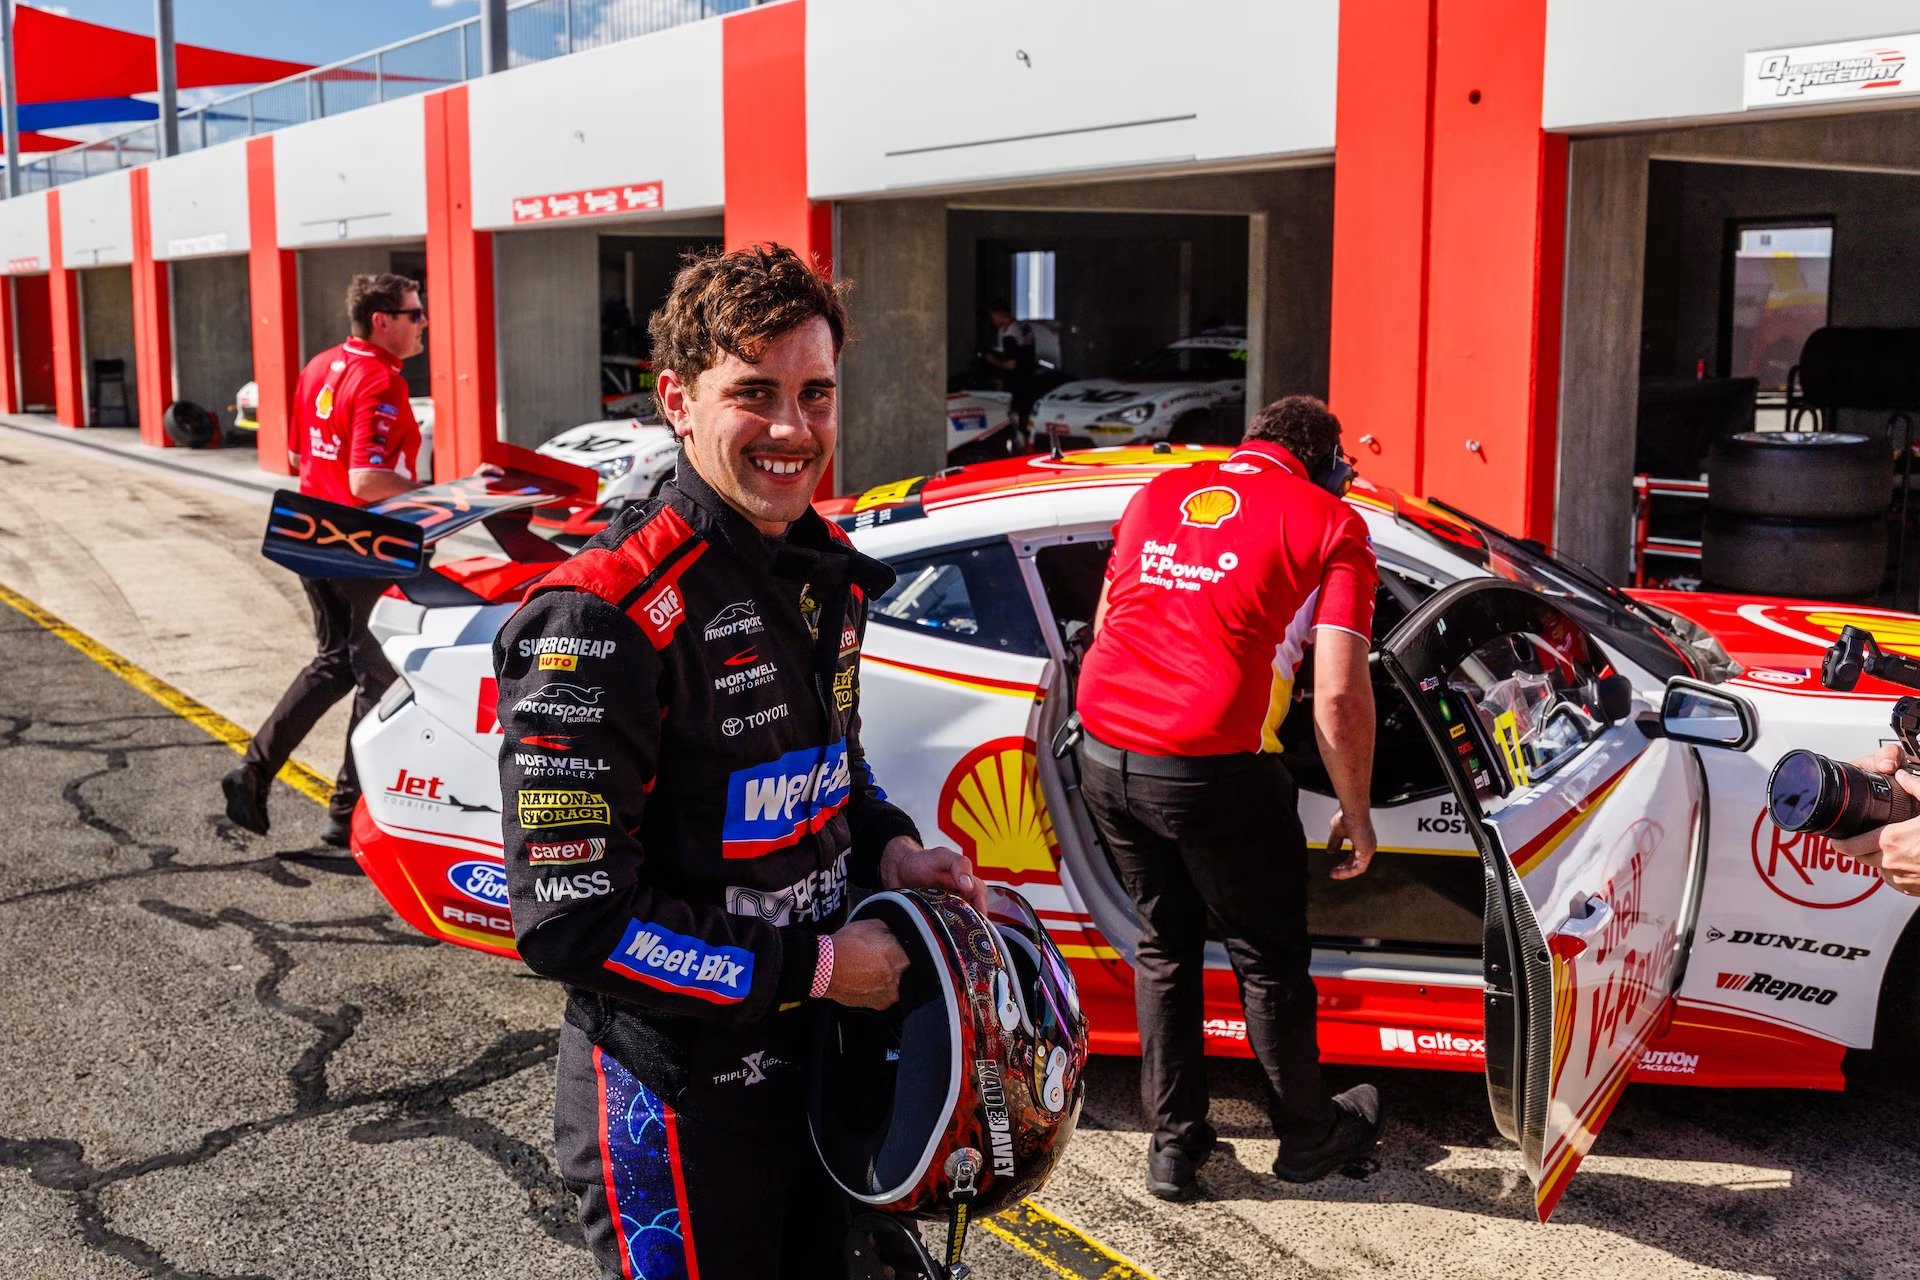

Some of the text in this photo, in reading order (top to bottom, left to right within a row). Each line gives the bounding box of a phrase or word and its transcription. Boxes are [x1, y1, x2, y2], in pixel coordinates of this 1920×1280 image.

[1776, 63, 1905, 97] RACEWAY
[269, 505, 421, 569] DXC
[1142, 540, 1177, 557] Shell
[1140, 553, 1226, 584] V-Power
[1139, 572, 1202, 592] Racing Team
[649, 589, 679, 626] OMP
[518, 636, 617, 660] SUPERCHEAP
[541, 657, 572, 668] AUTO
[714, 661, 778, 690] NORWELL
[728, 676, 776, 695] MOTORPLEX
[745, 702, 789, 729] TOYOTA
[514, 752, 611, 771] NORWELL
[523, 766, 595, 780] MOTORPLEX
[386, 768, 445, 800] Jet
[383, 796, 441, 813] COURIERS
[521, 792, 606, 806] NATIONAL
[523, 808, 603, 823] STORAGE
[1417, 817, 1470, 834] KOST
[531, 842, 585, 859] carey
[465, 865, 509, 900] For
[442, 905, 514, 931] RAC
[1727, 929, 1871, 961] DUNLOP
[624, 930, 746, 989] Weet-Bix
[1742, 971, 1839, 1006] Repco
[1417, 1031, 1486, 1053] alfex
[712, 1057, 791, 1085] TRIPLE EIG
